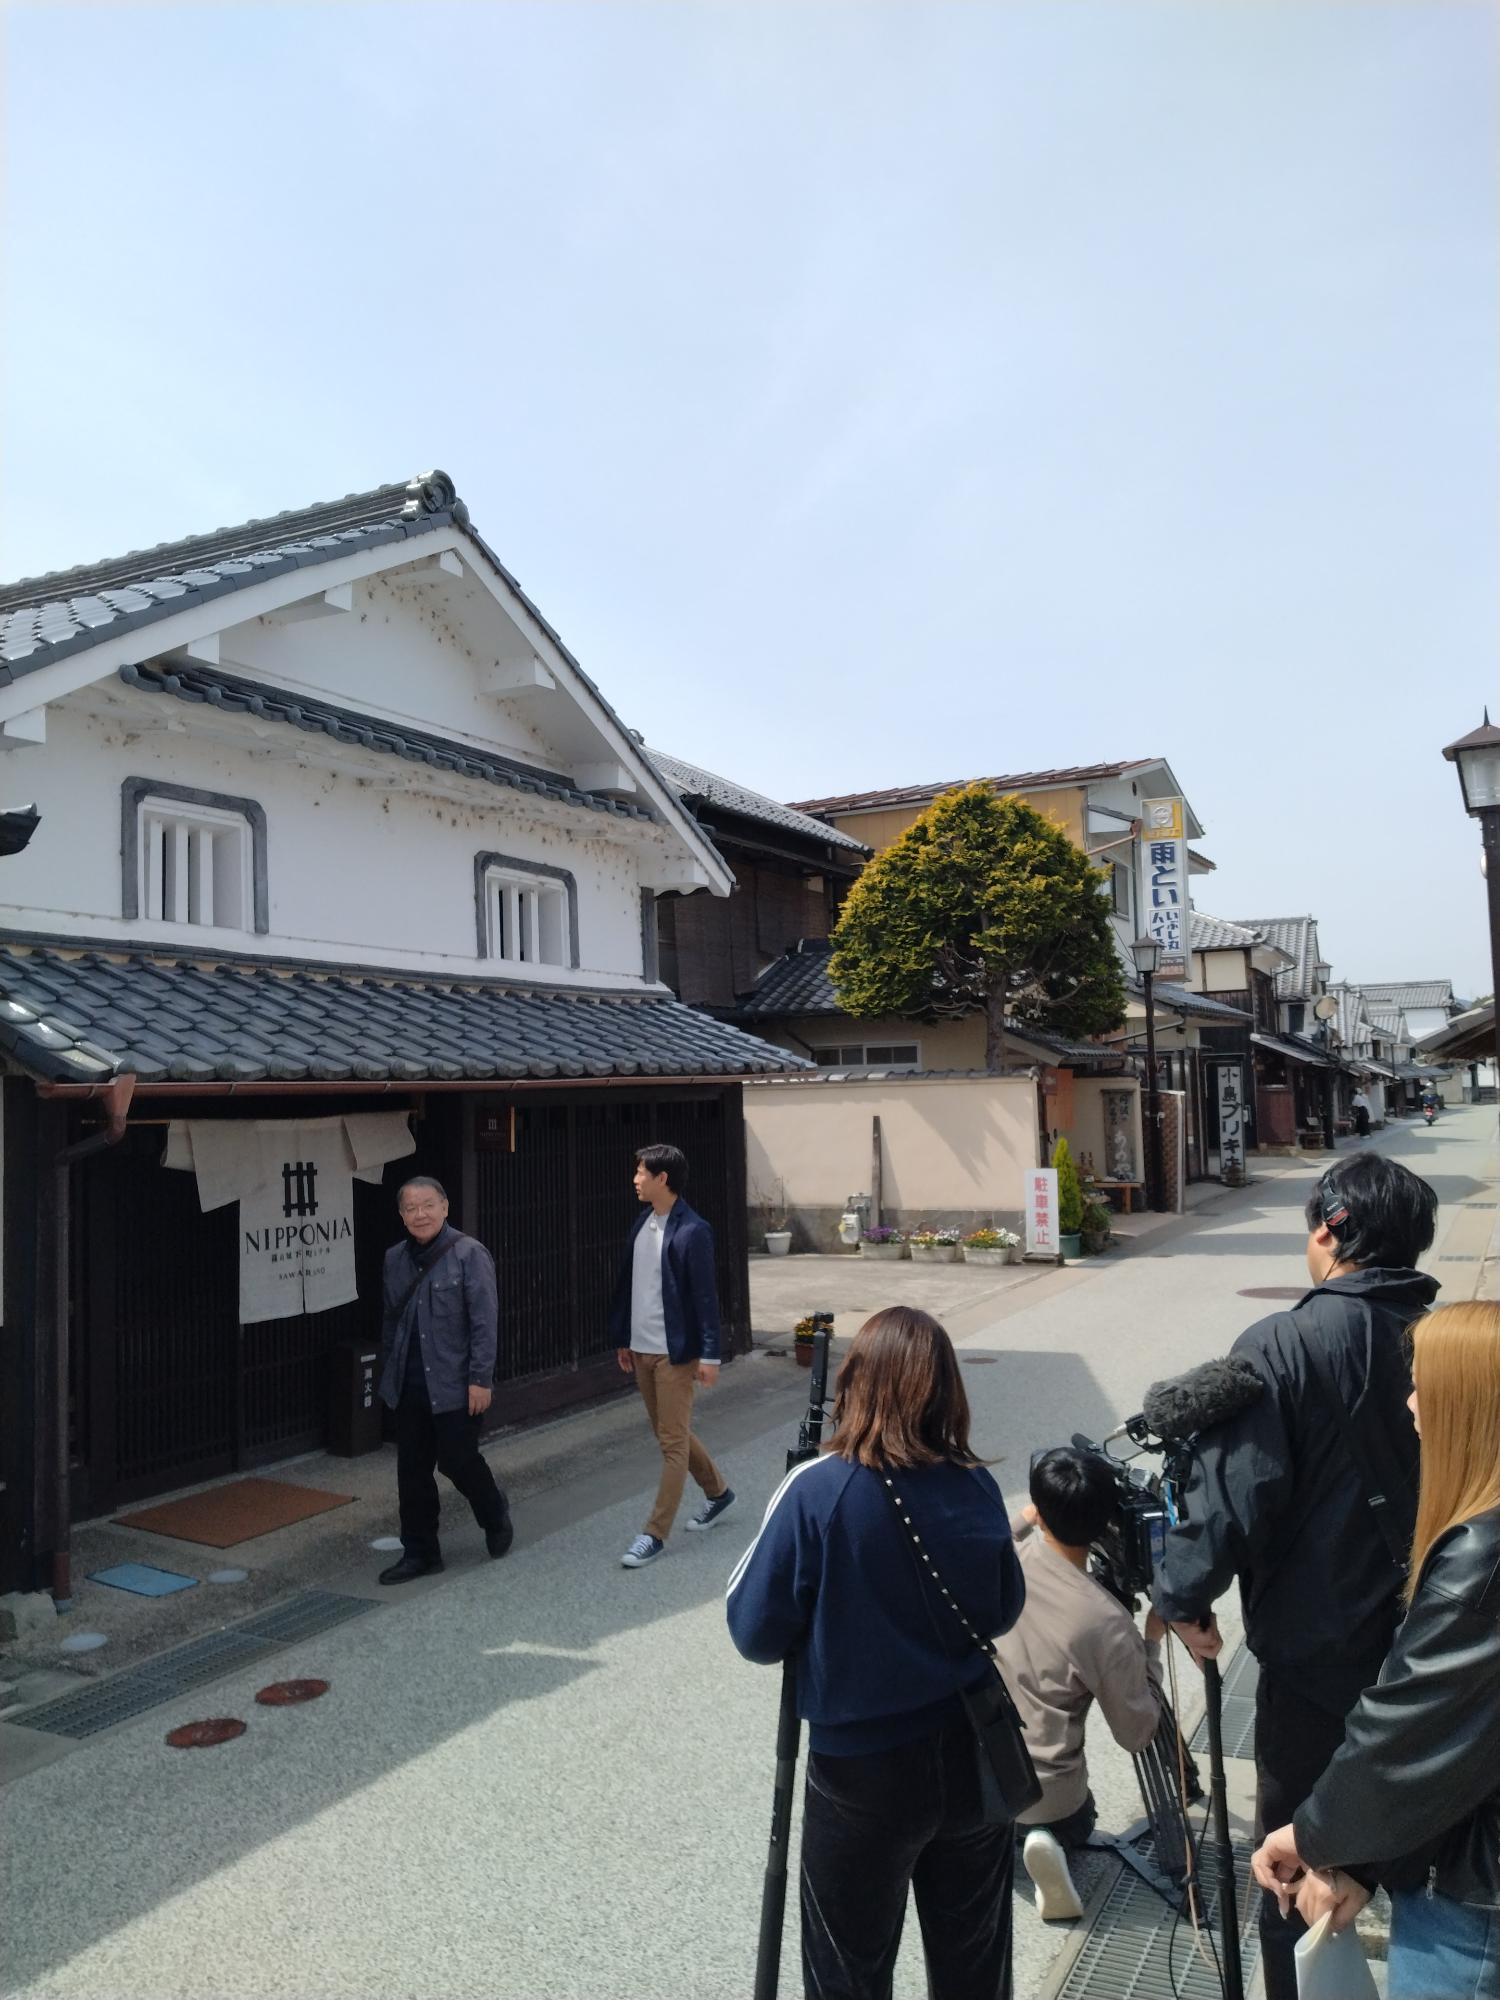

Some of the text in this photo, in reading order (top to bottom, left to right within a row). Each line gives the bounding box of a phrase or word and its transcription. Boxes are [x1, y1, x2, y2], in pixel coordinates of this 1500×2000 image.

[1150, 842, 1178, 908] 雨とい
[246, 1217, 352, 1254] NIPPONIA
[1034, 1176, 1050, 1245] 駐車禁止
